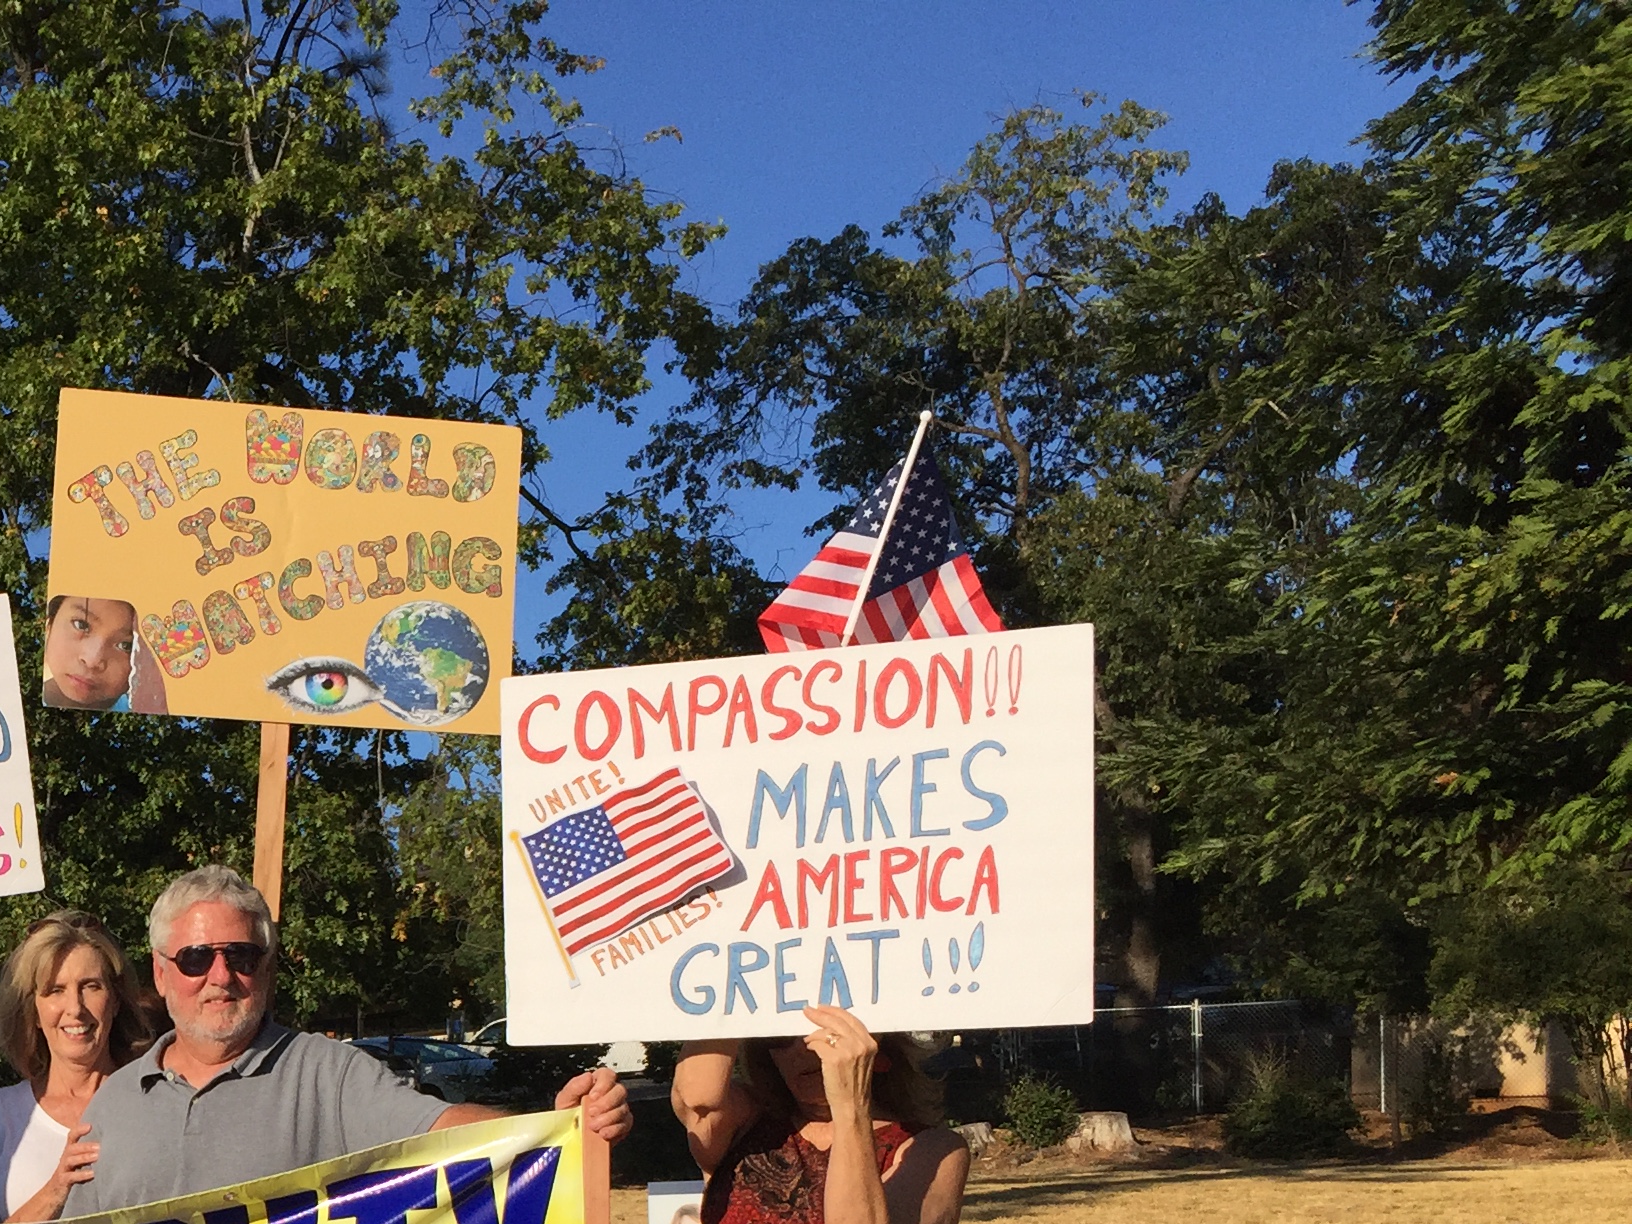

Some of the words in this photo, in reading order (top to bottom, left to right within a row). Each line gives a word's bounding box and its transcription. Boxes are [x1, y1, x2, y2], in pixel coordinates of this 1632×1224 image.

[67, 429, 221, 537] THE
[246, 409, 496, 502] WORLD
[177, 496, 271, 575] IS
[141, 530, 502, 678] WATCHING
[518, 644, 1022, 764] COMPASSION!!
[529, 762, 626, 823] UNITE!
[746, 740, 1008, 849] MAKES
[590, 886, 723, 976] FAMILIES!
[740, 844, 1000, 932] AMERICA
